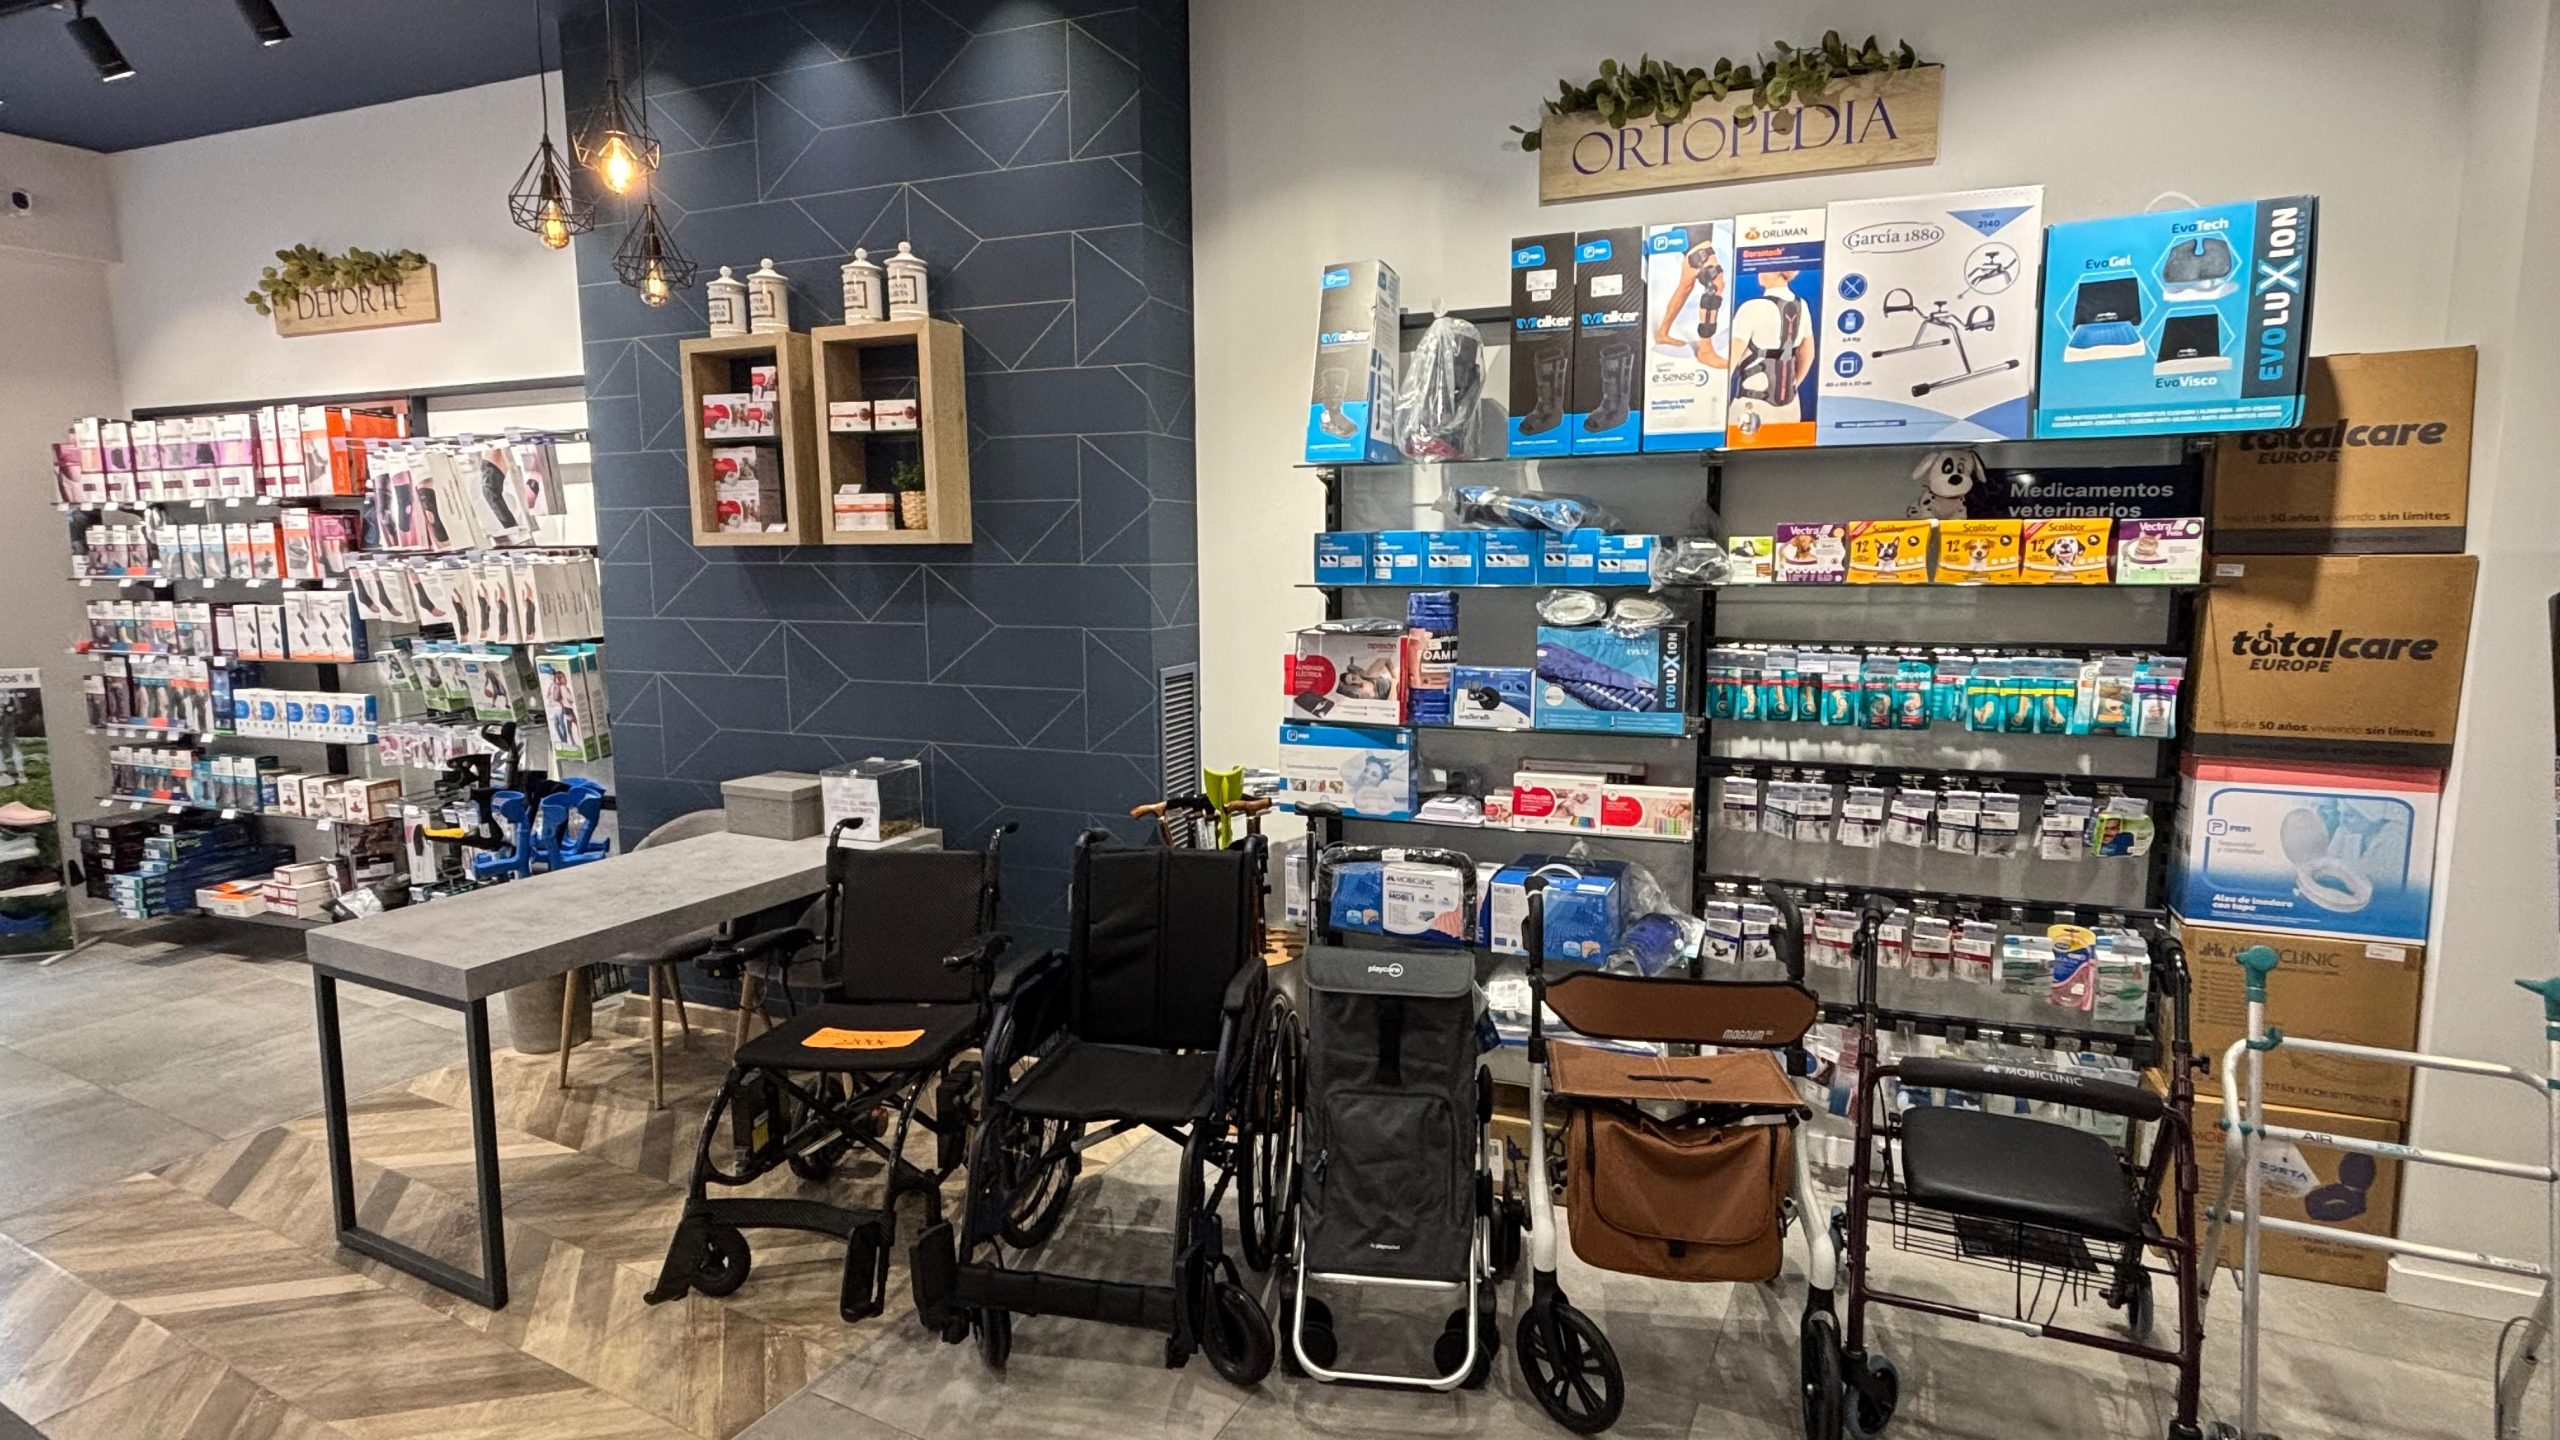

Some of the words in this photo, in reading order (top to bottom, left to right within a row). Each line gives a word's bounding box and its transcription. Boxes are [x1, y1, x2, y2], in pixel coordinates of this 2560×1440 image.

[1572, 96, 1898, 175] ORTOPEDIA
[1978, 218, 2000, 229] 2140
[2172, 217, 2229, 233] EvoTech
[1762, 227, 1808, 239] ORLIMAN
[1847, 229, 1900, 249] García
[1904, 228, 1940, 243] 1880
[2085, 255, 2132, 270] EvoGel
[298, 281, 406, 320] DEPORTE
[2155, 375, 2218, 389] EvoVisco
[2238, 418, 2448, 450] totalcare
[2257, 452, 2339, 464] EUROPE
[2010, 482, 2174, 498] Medicamentos
[2009, 501, 2141, 518] veterinarios
[2379, 511, 2399, 520] sin
[1790, 526, 1819, 536] Vectra
[1963, 523, 1998, 532] Scalibor
[2049, 523, 2086, 532] Scalibor
[2140, 521, 2172, 531] Vectra
[1855, 540, 1869, 553] 12
[1946, 539, 1960, 552] 12
[2031, 538, 2045, 552] 12
[2232, 627, 2439, 661] totalcare
[2250, 659, 2332, 673] EUROPE
[2259, 721, 2274, 731] 50
[2366, 727, 2385, 736] sin
[2005, 1066, 2084, 1088] MOBICLINIC
[2302, 1132, 2334, 1144] AIR
